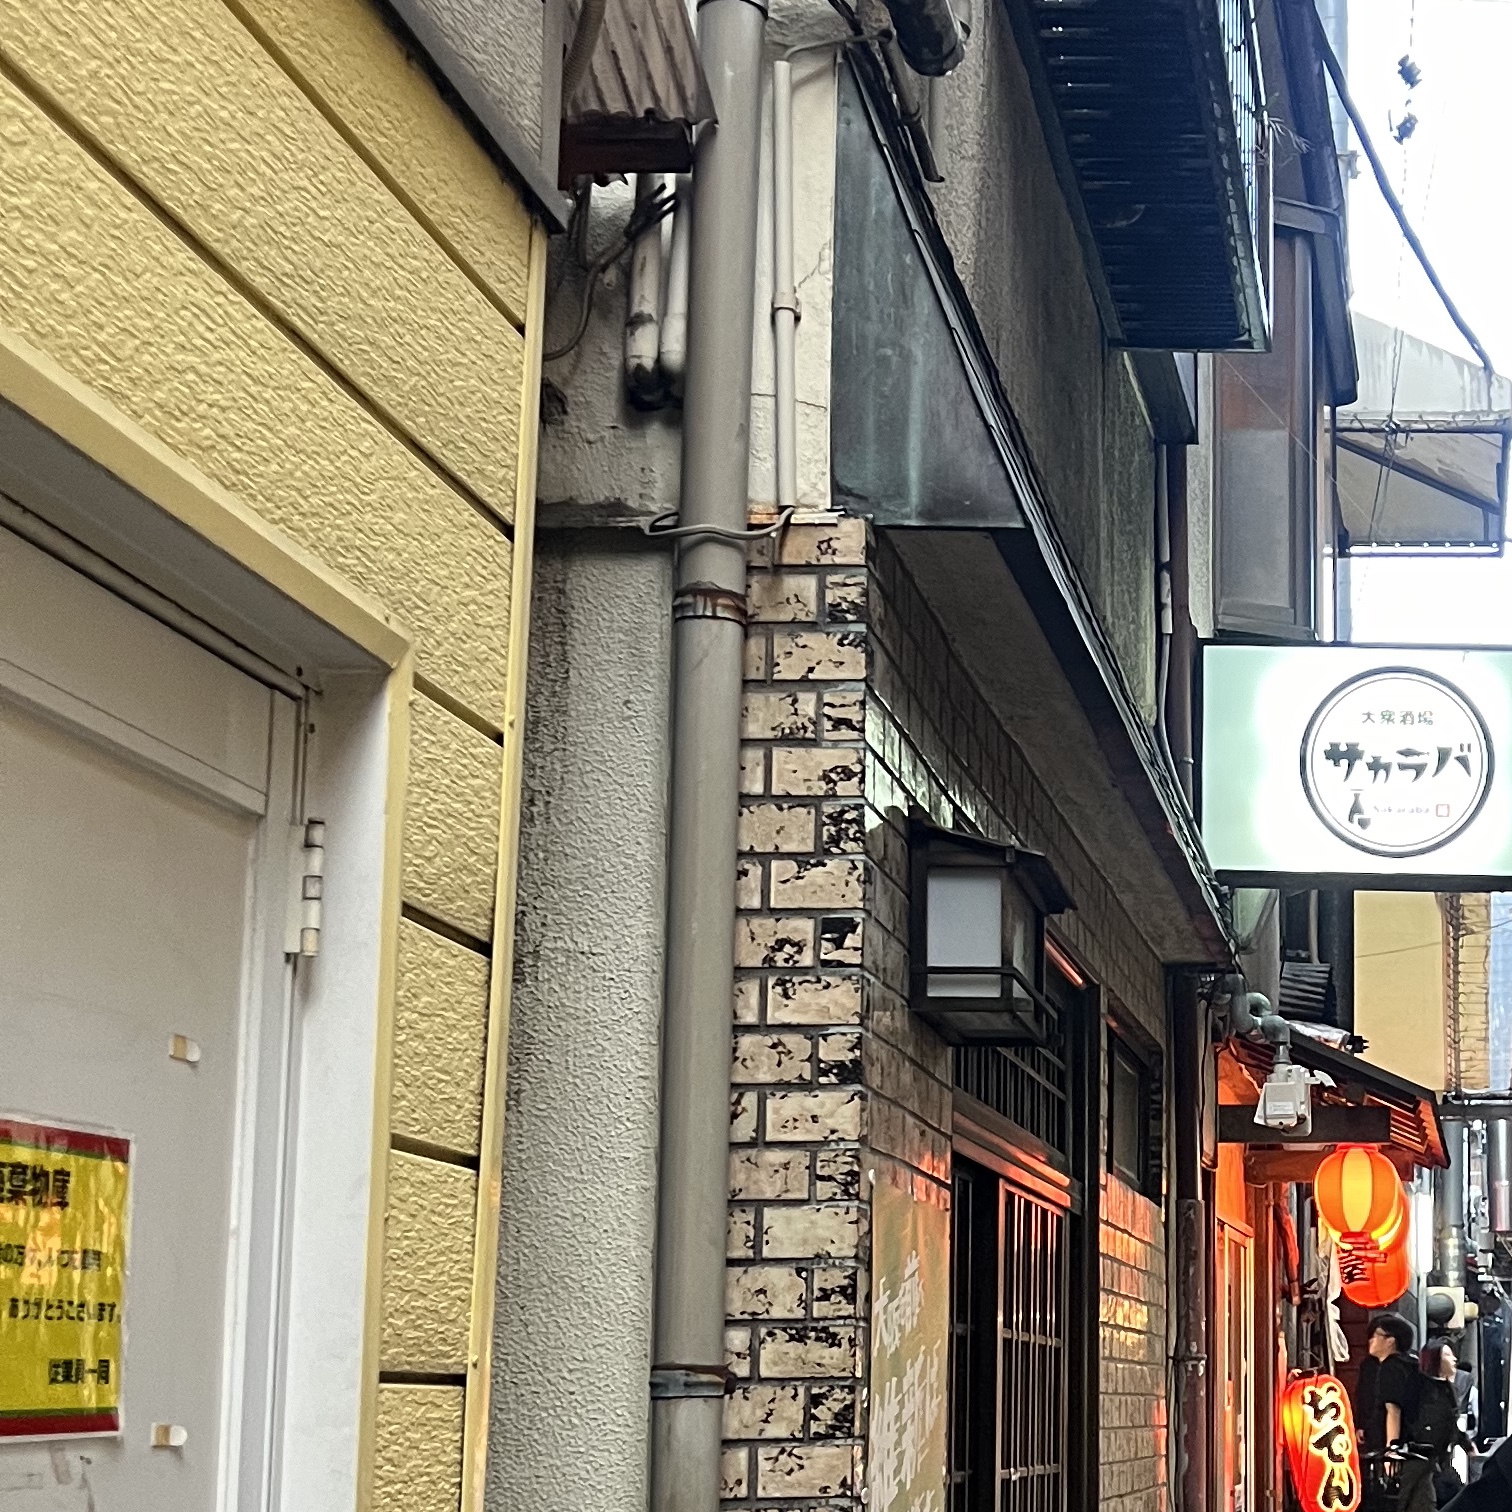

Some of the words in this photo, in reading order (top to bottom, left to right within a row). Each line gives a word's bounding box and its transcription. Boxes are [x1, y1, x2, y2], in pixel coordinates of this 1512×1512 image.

[1361, 710, 1434, 726] 大衆酒場
[1302, 1384, 1354, 1509] おでん
